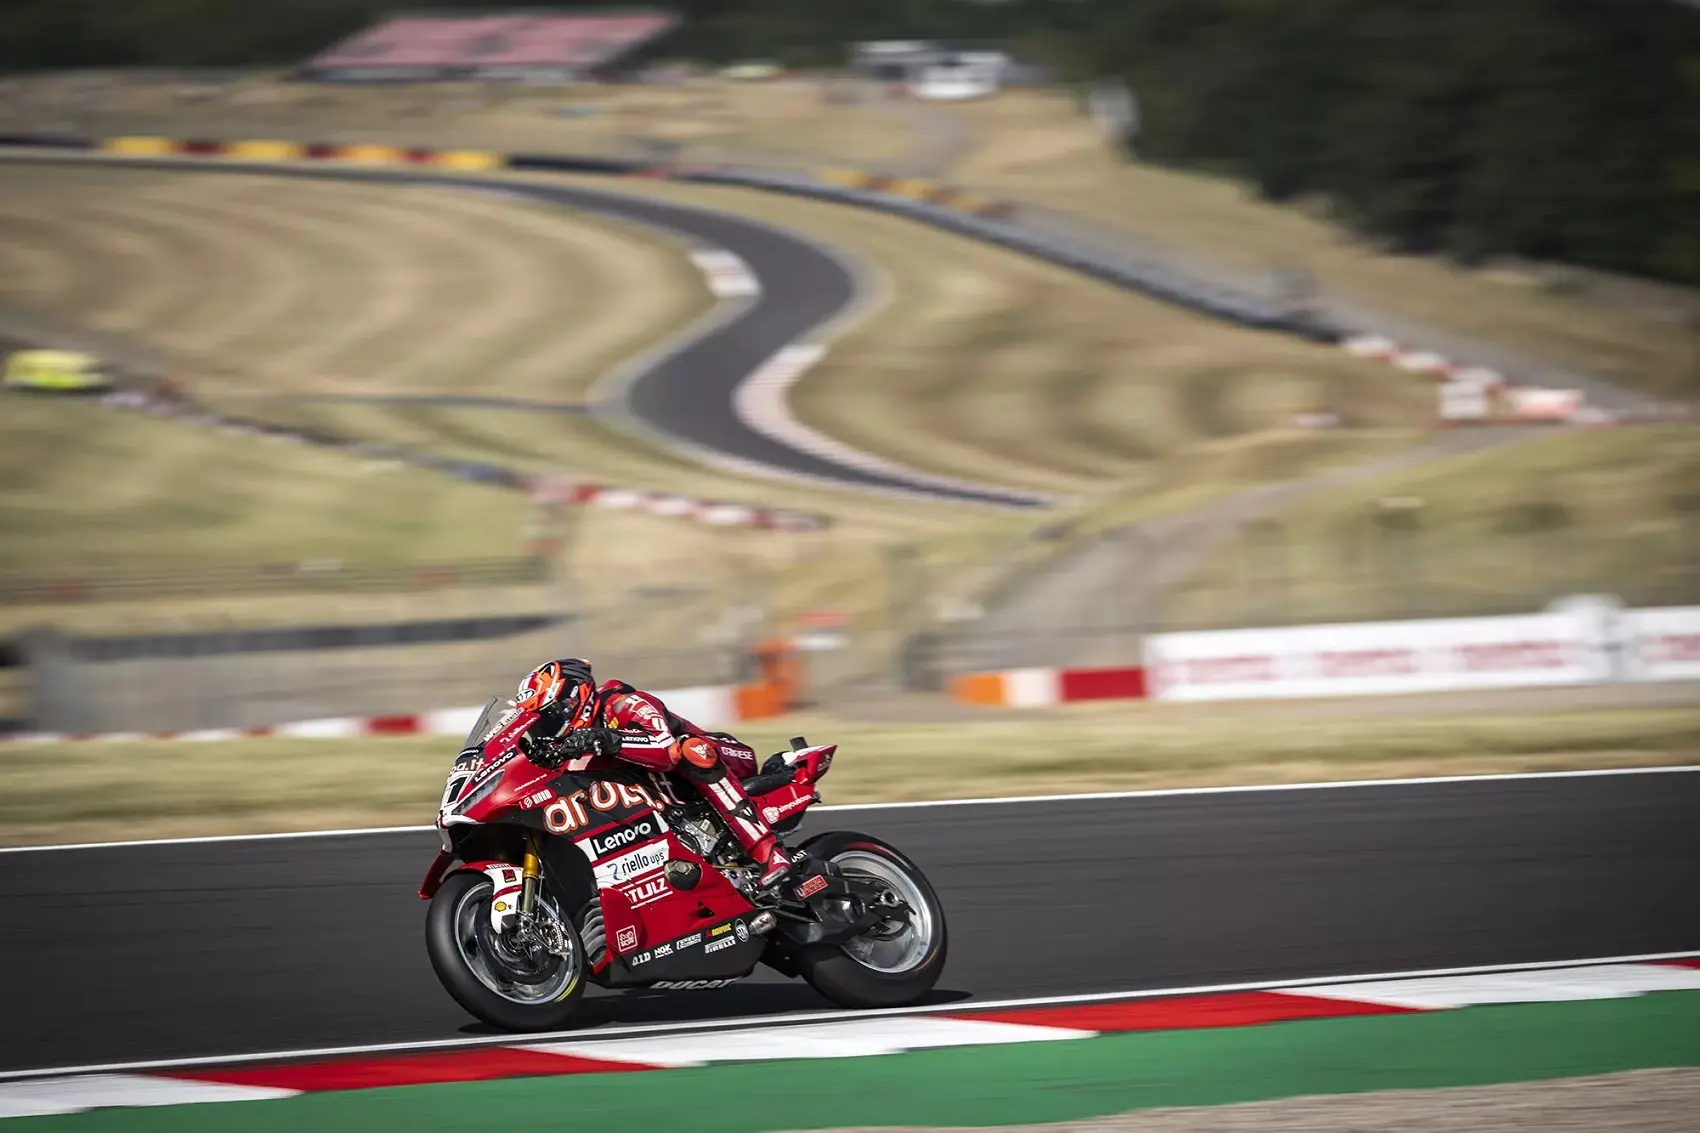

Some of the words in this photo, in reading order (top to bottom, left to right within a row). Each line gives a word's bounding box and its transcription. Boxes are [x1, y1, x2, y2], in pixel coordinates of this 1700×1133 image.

[621, 735, 649, 743] Lenovo
[474, 751, 514, 783] Lenovo
[593, 821, 652, 855] Lenovo
[621, 854, 650, 877] riello
[649, 851, 665, 866] ups
[625, 877, 669, 904] TULZ
[704, 935, 736, 954] PIRELLI
